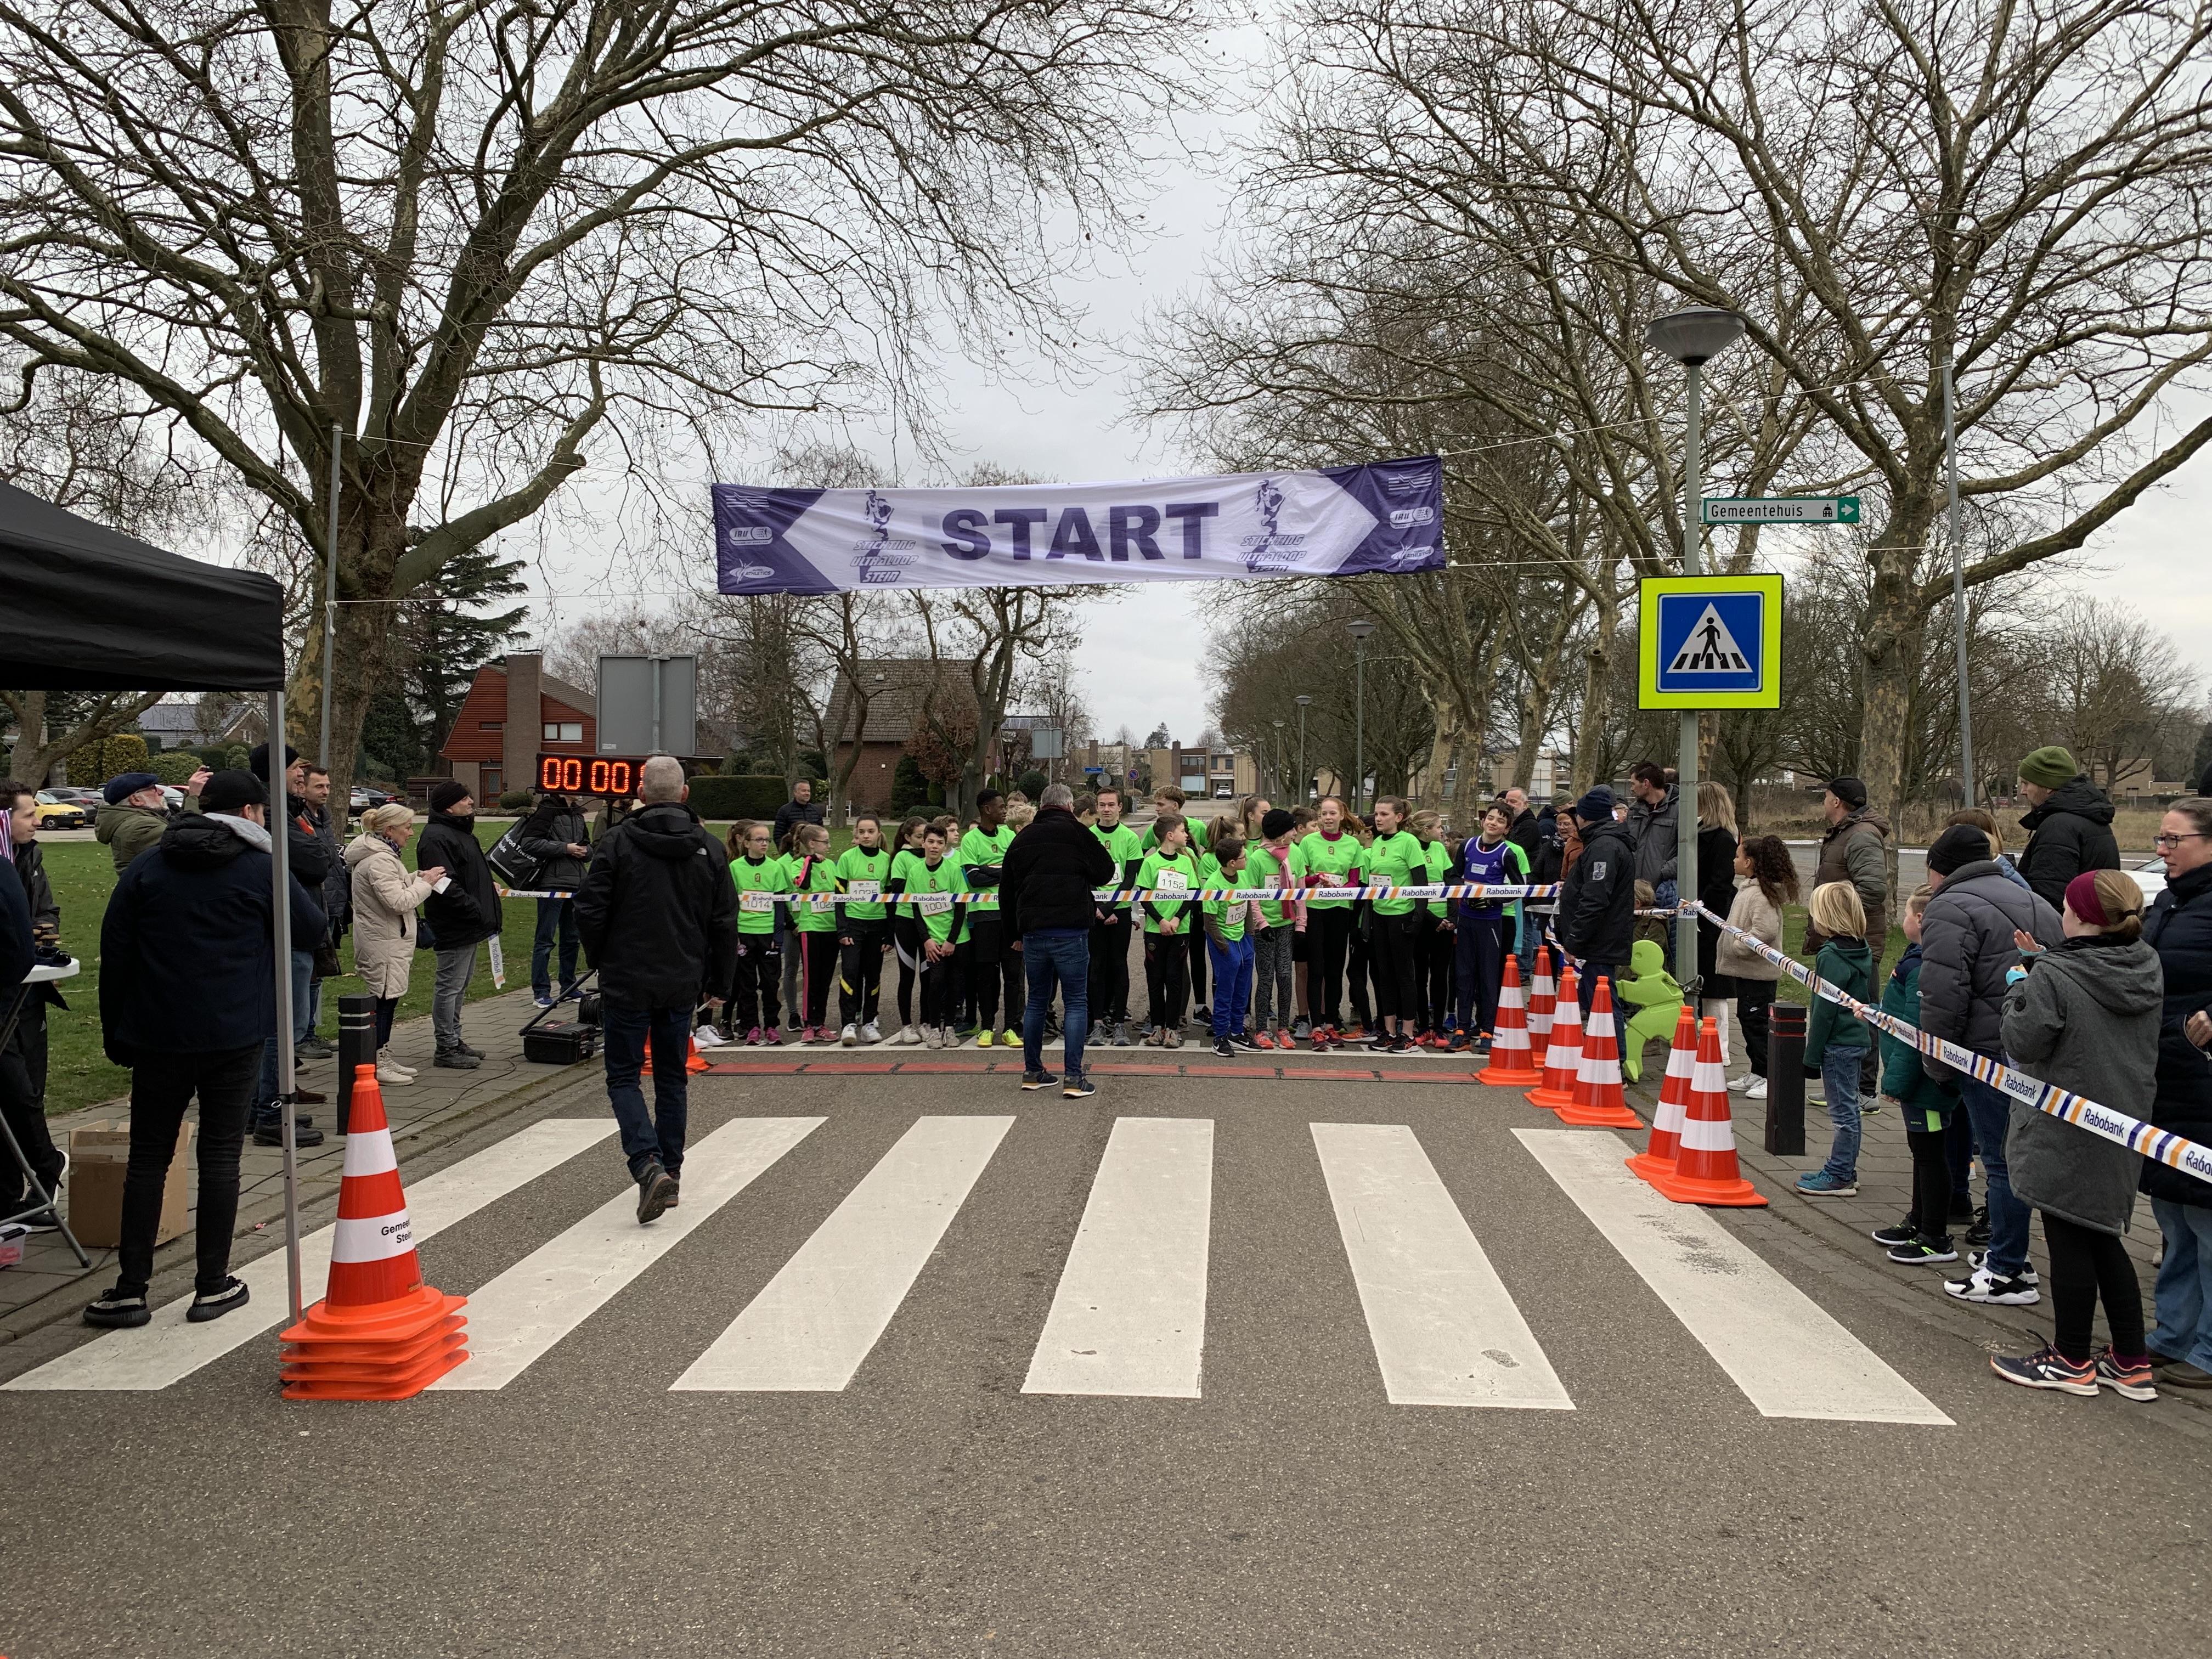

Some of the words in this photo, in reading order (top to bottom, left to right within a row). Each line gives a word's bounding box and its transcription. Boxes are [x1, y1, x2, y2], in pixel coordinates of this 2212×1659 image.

[1711, 504, 1803, 517] Gemeentehuis
[941, 502, 1219, 562] START
[853, 540, 916, 550] STICHTING
[1240, 534, 1305, 546] STICHTING
[850, 555, 919, 567] ULTRALOOP
[1237, 551, 1307, 562] ULTRALOOP
[862, 571, 901, 583] STEIN
[1162, 879, 1184, 890] 1152
[1943, 1046, 1968, 1069] Rabobank
[2004, 1074, 2036, 1099] Rabobank
[2084, 1108, 2125, 1138] Rabobank
